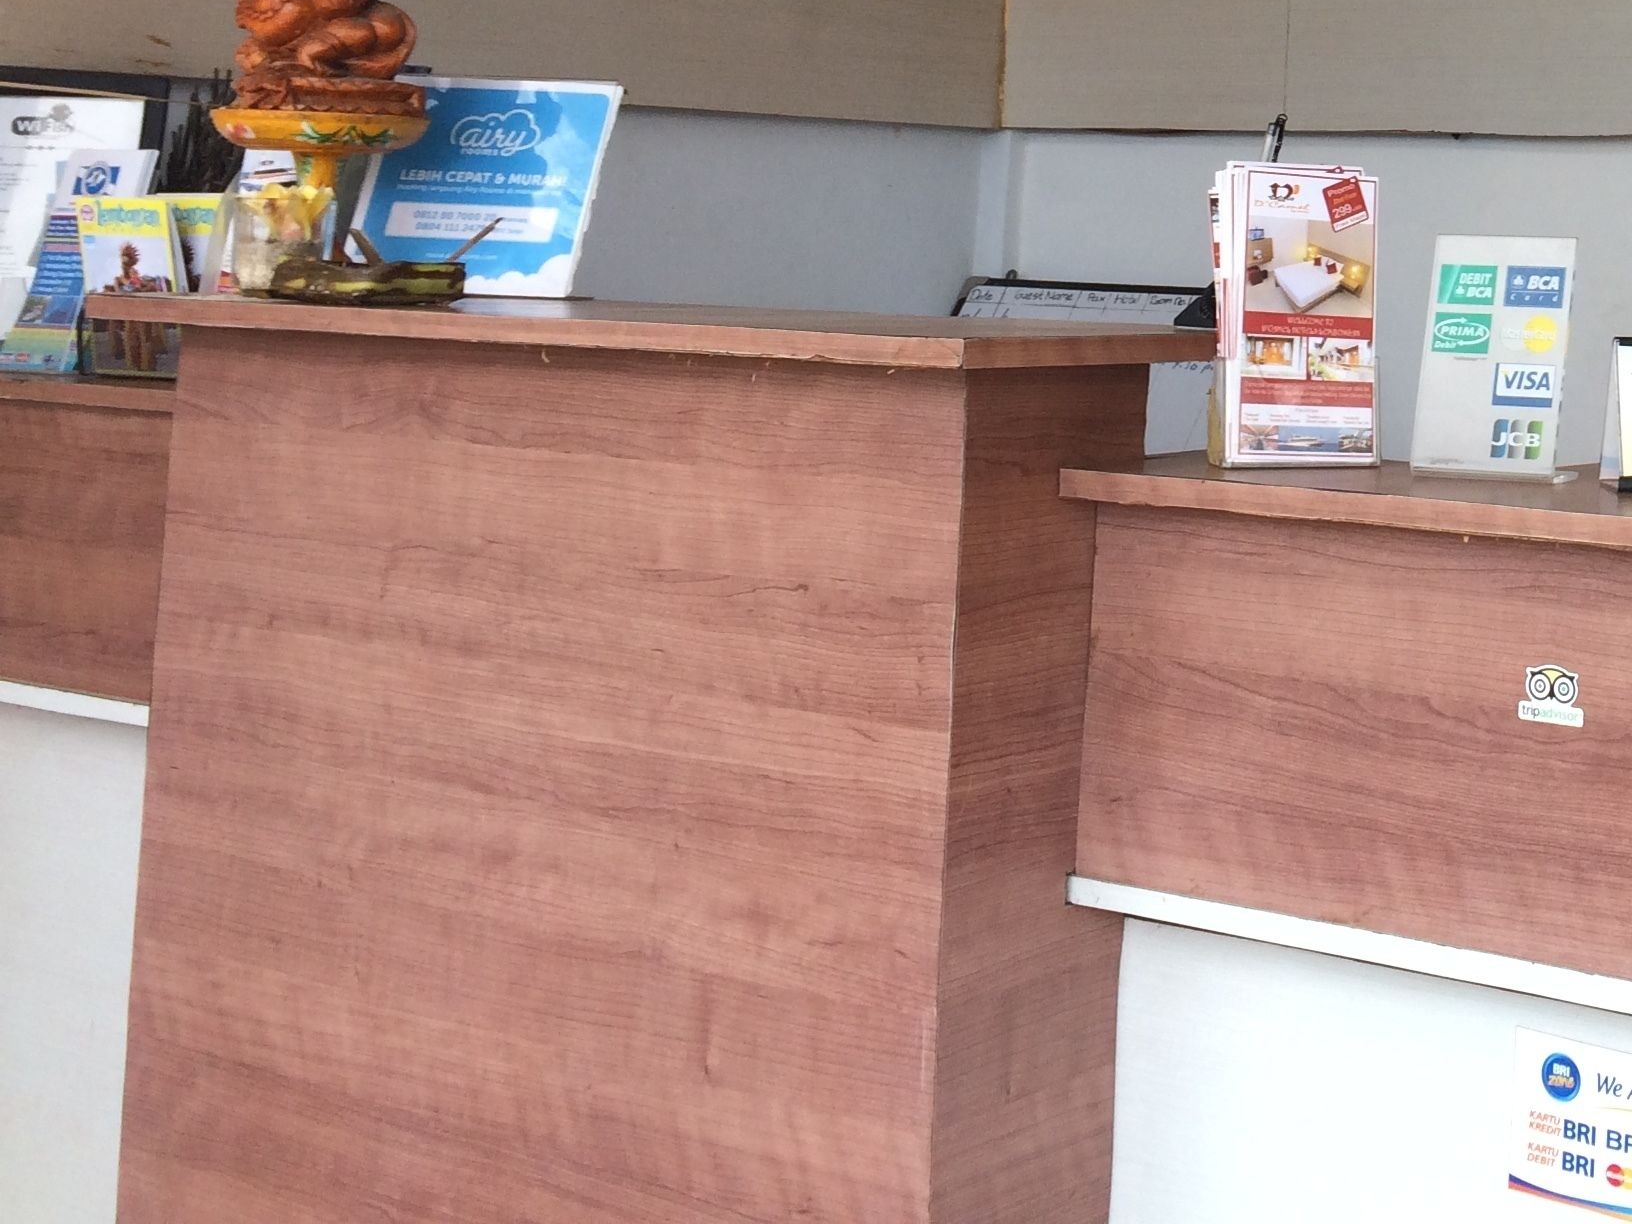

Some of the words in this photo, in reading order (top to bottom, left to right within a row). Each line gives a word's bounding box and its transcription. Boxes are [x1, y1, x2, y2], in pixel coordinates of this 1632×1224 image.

[460, 121, 528, 157] airy
[460, 148, 499, 156] rooms
[400, 169, 442, 182] LEBIH
[445, 171, 492, 183] CEPAT
[495, 173, 505, 184] &
[1459, 273, 1492, 285] DEBIT
[1527, 276, 1560, 291] BCA
[970, 288, 993, 301] Date
[1466, 287, 1492, 298] BCA
[1440, 326, 1484, 337] PRIMA
[1504, 370, 1551, 391] VISA
[1491, 432, 1541, 447] JCB
[1522, 704, 1579, 722] tripadvisor
[1552, 1062, 1570, 1077] BRI
[1597, 1073, 1622, 1097] We
[1530, 1110, 1561, 1126] KARTU
[1529, 1121, 1562, 1137] KREDIT
[1563, 1118, 1596, 1146] BRI
[1528, 1142, 1559, 1158] KARTU
[1527, 1152, 1556, 1168] DEBIT
[1562, 1150, 1595, 1178] BRI
